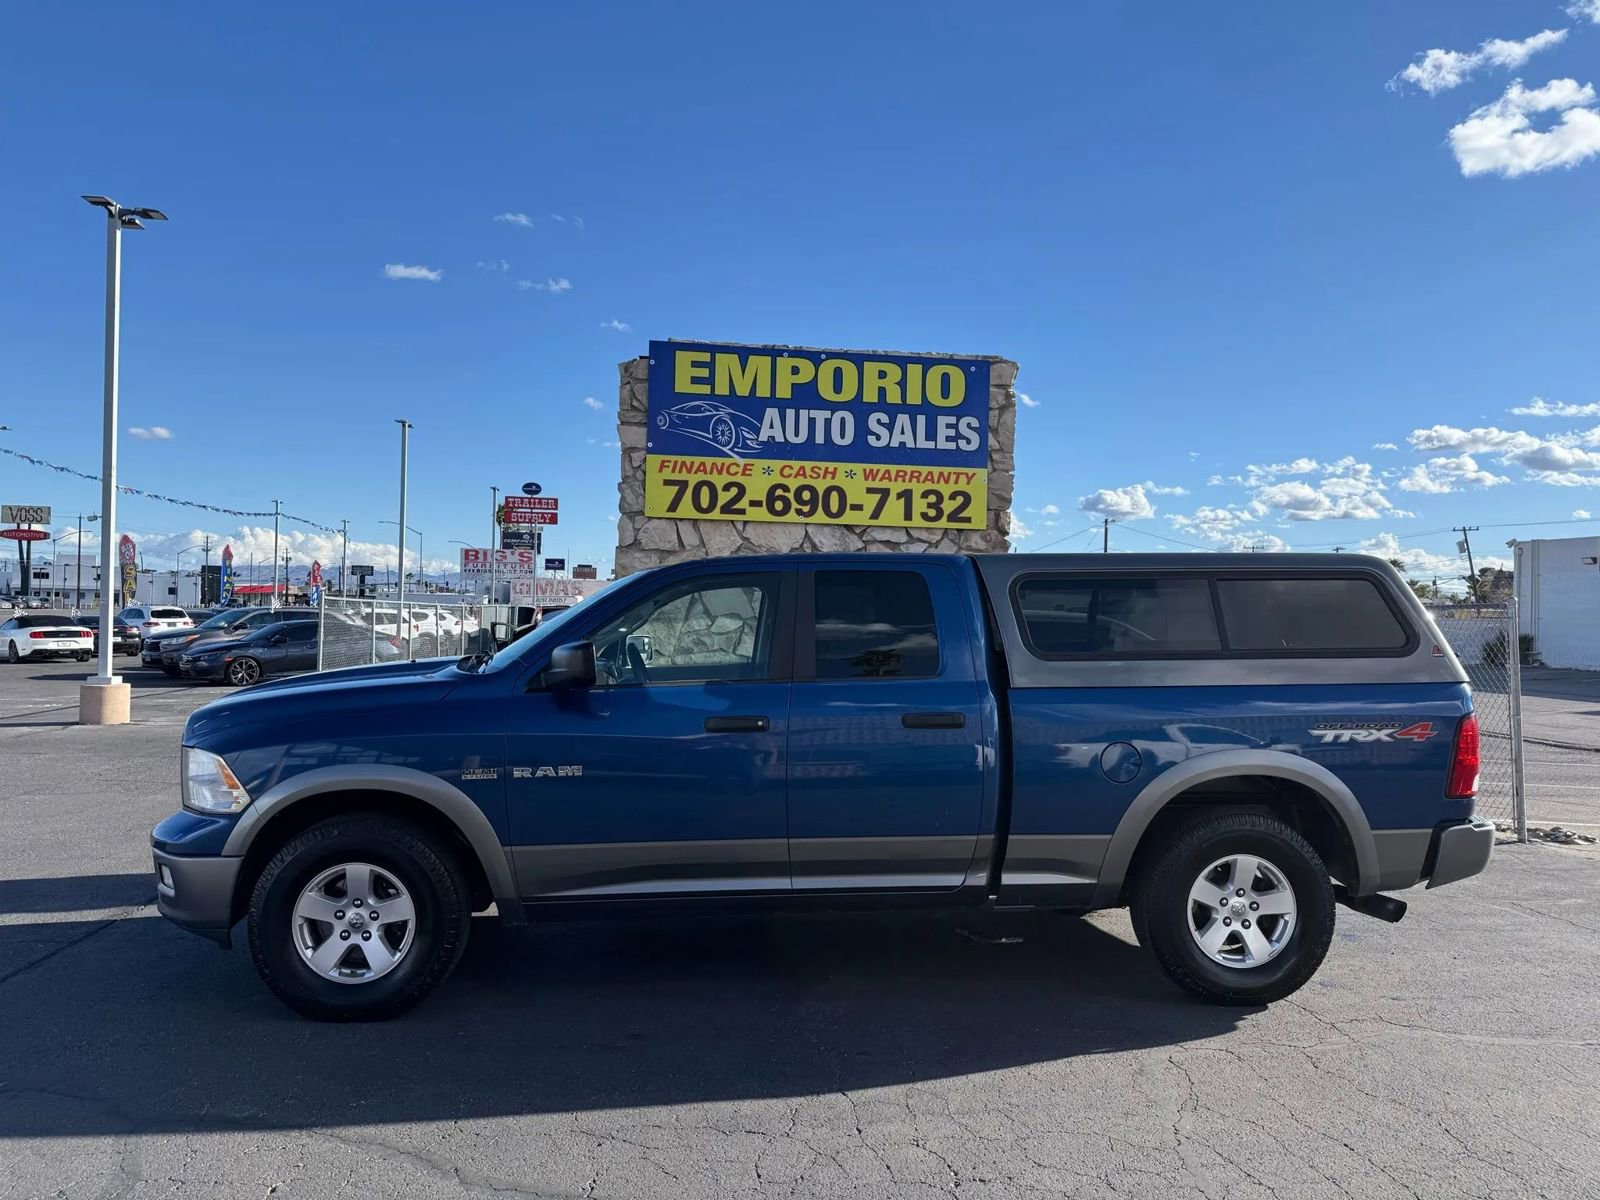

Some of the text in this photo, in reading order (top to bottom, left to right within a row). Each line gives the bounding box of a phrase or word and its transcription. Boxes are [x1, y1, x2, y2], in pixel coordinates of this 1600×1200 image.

[674, 350, 966, 407] EMPORIO
[758, 407, 981, 452] AUTO SALES
[657, 459, 976, 486] FINANCE CASH WARRANTY
[507, 497, 556, 509] TRAILER
[662, 478, 973, 524] 702-690-7132
[8, 506, 43, 523] VOSS
[511, 512, 552, 523] SUPPLY
[2, 531, 45, 539] AUTOMOTIVE
[464, 549, 533, 563] BIG'S
[513, 765, 583, 778] RAM
